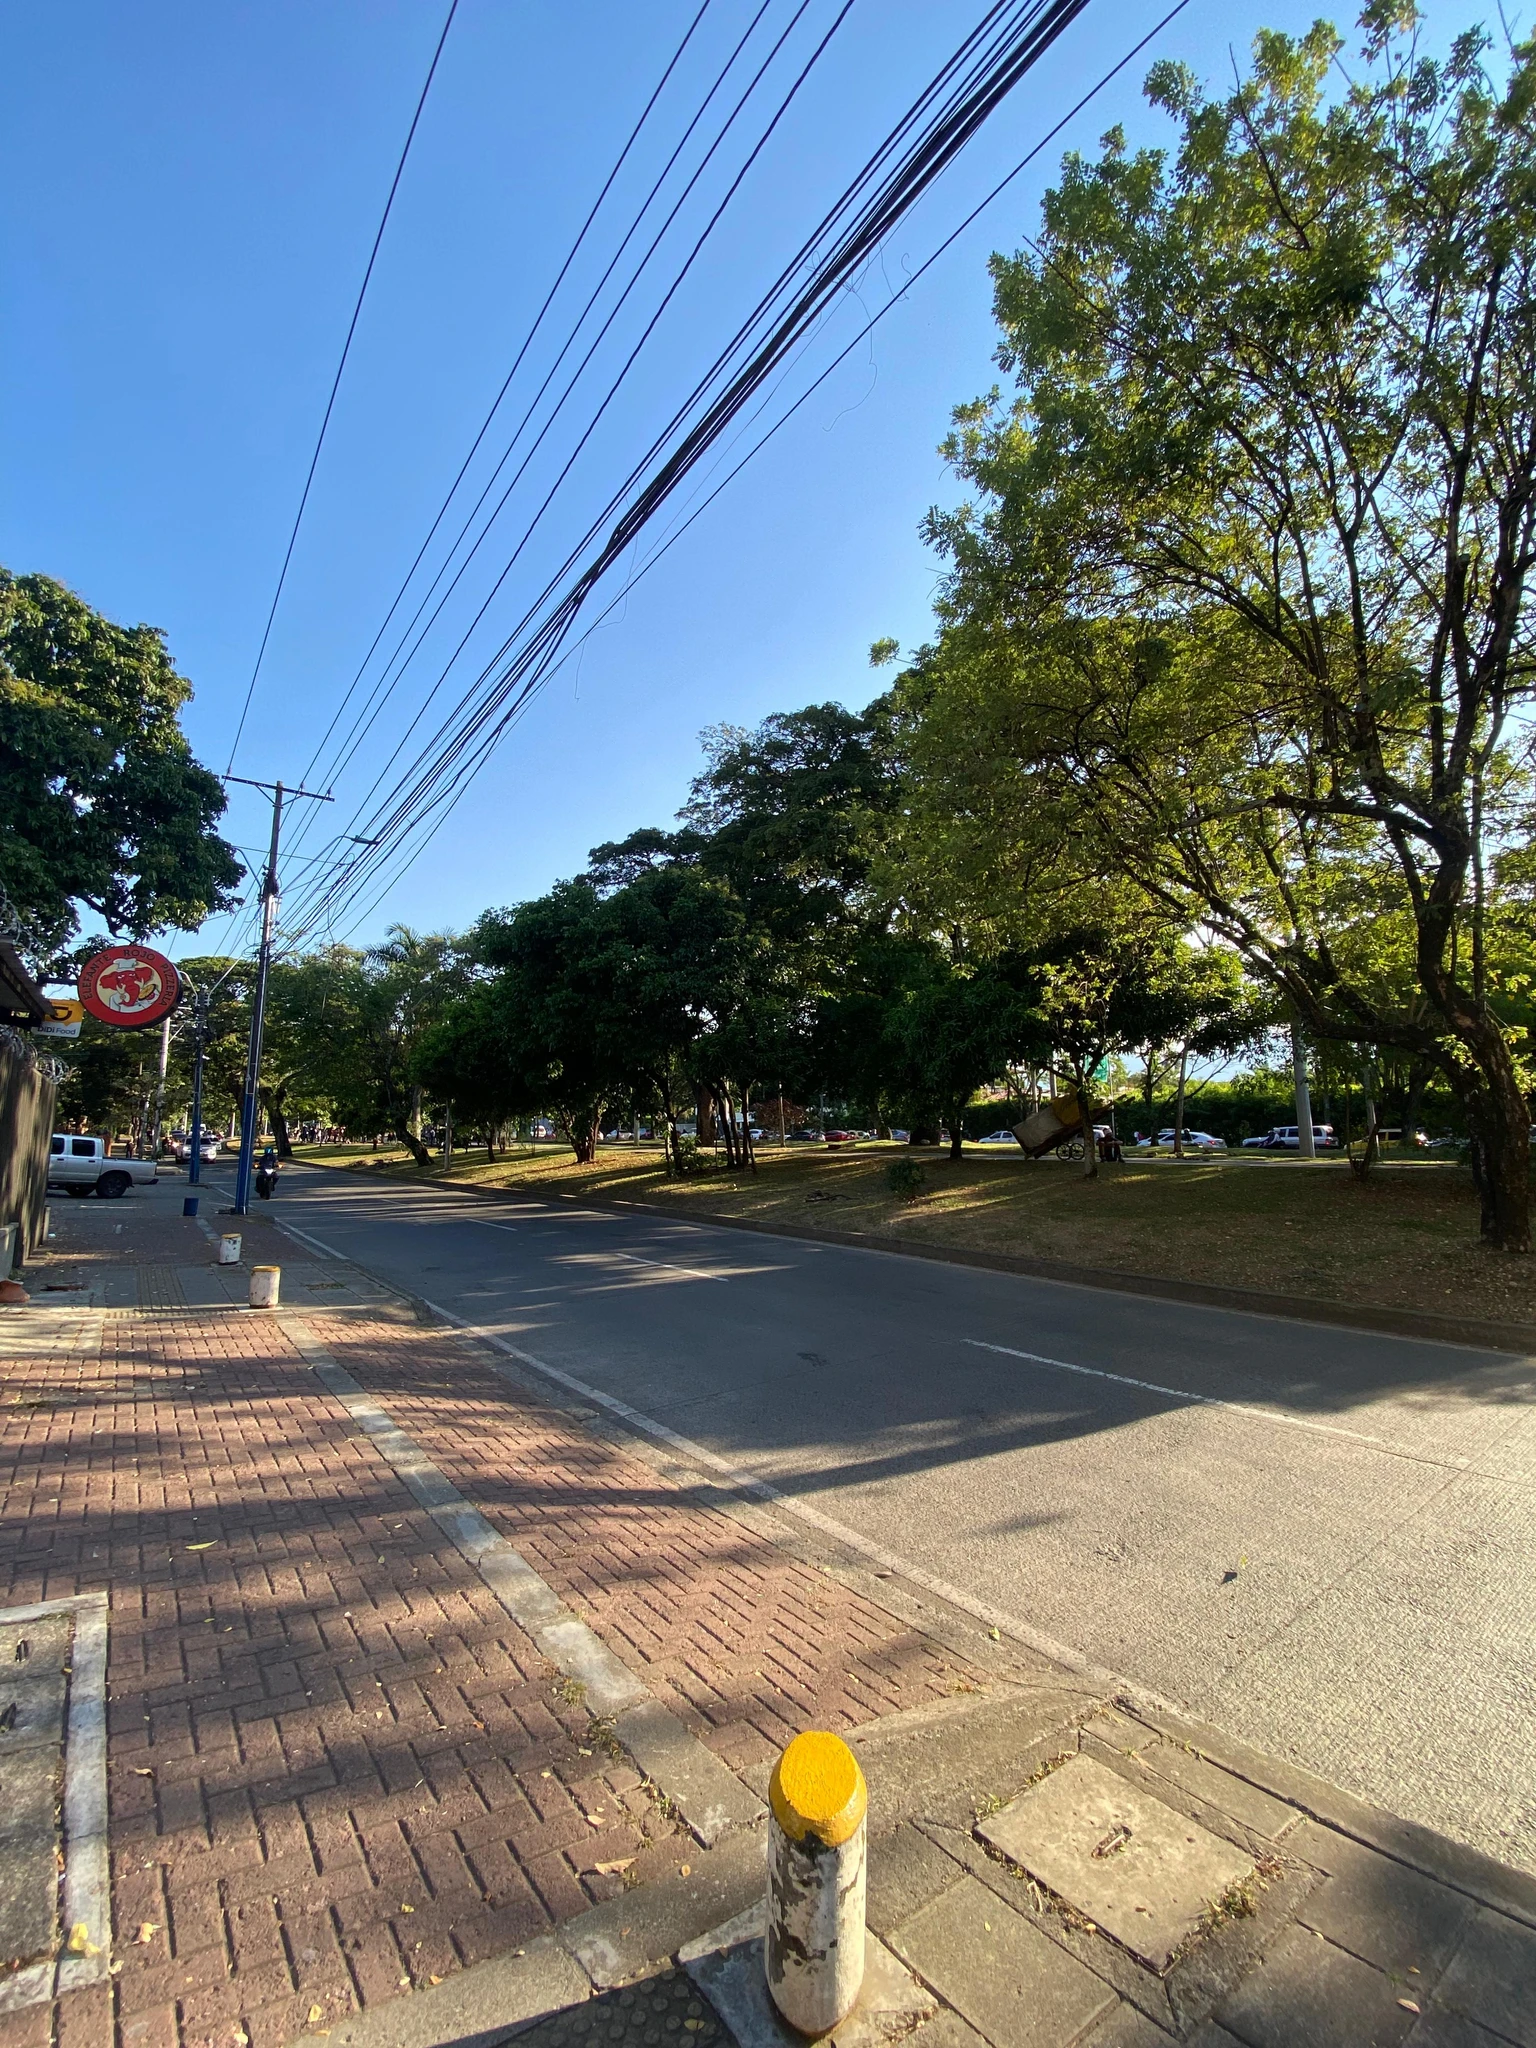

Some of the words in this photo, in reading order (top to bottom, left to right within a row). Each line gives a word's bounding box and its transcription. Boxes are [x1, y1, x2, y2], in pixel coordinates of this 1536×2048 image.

[82, 954, 112, 1000] ELEFANTE
[123, 949, 156, 961] ROJO
[160, 963, 175, 1007] PIZZERIA
